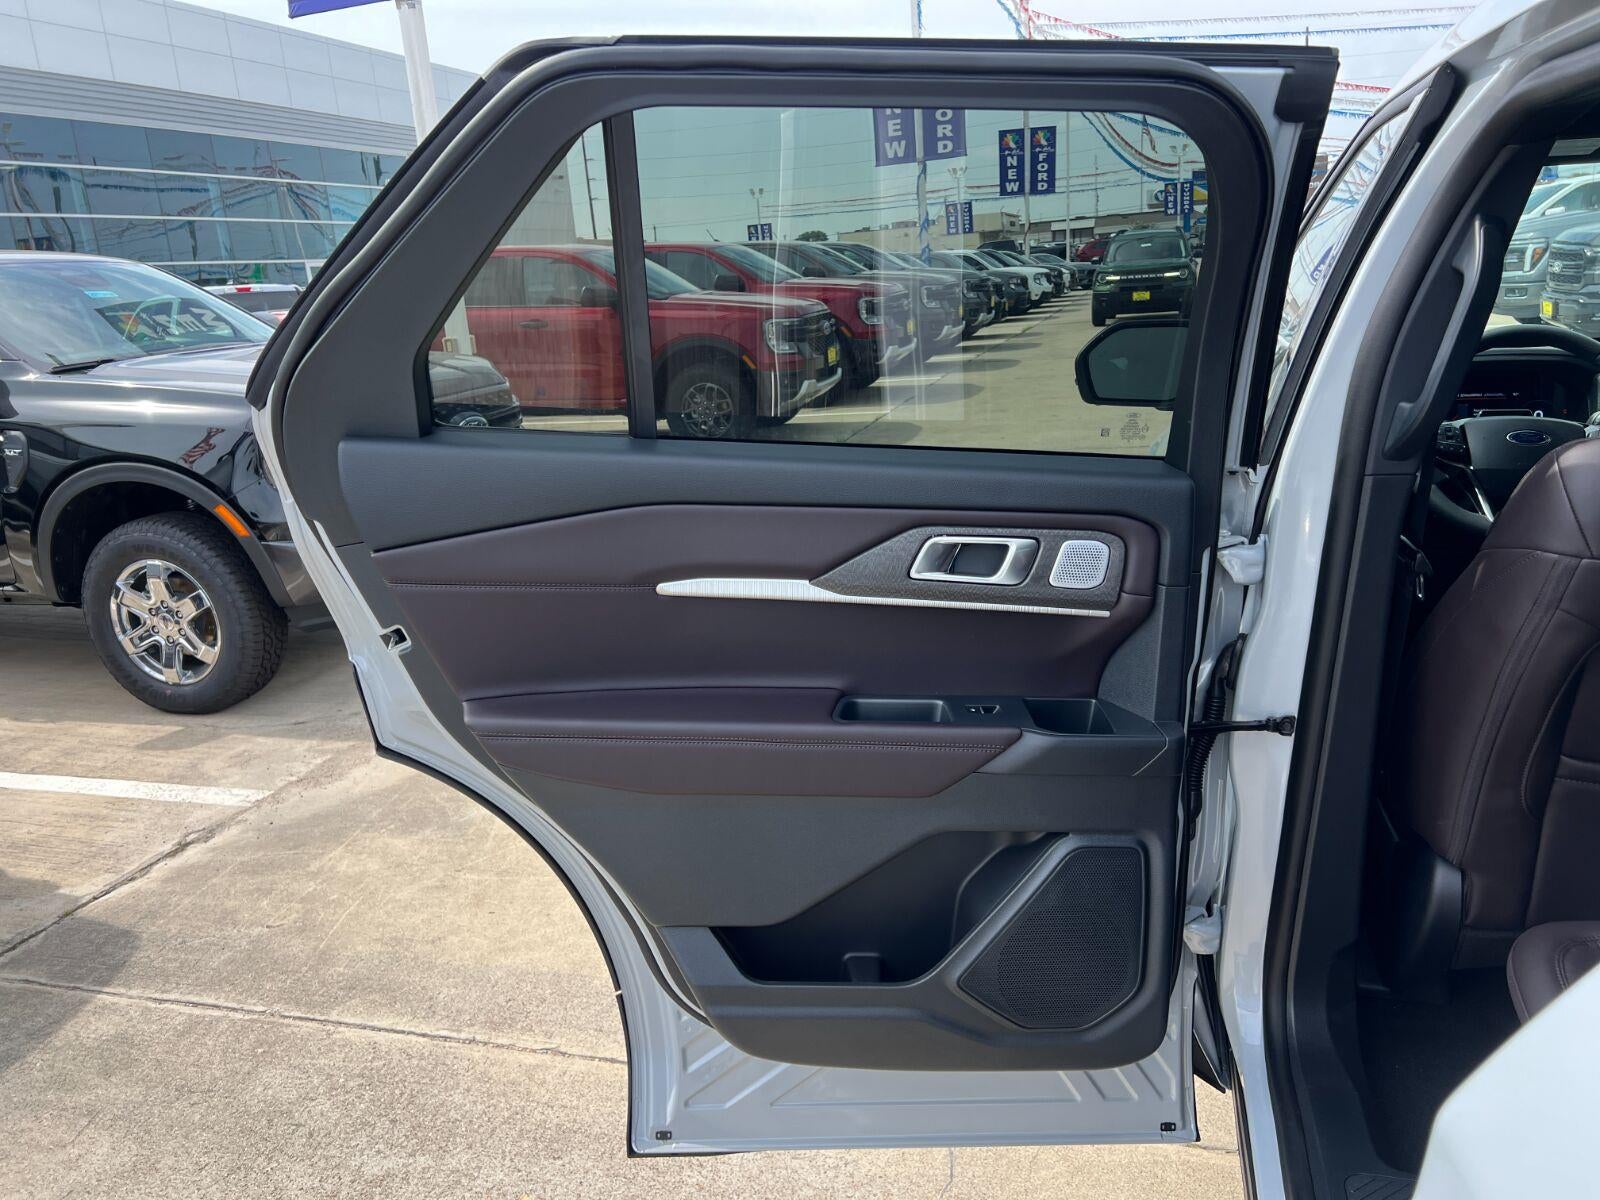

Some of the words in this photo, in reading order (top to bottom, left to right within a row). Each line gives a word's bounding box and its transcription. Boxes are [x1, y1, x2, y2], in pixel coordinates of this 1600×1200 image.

[935, 109, 953, 153] ORD
[1005, 155, 1020, 193] NEW
[1037, 153, 1048, 191] FORD
[1166, 195, 1175, 215] NEW
